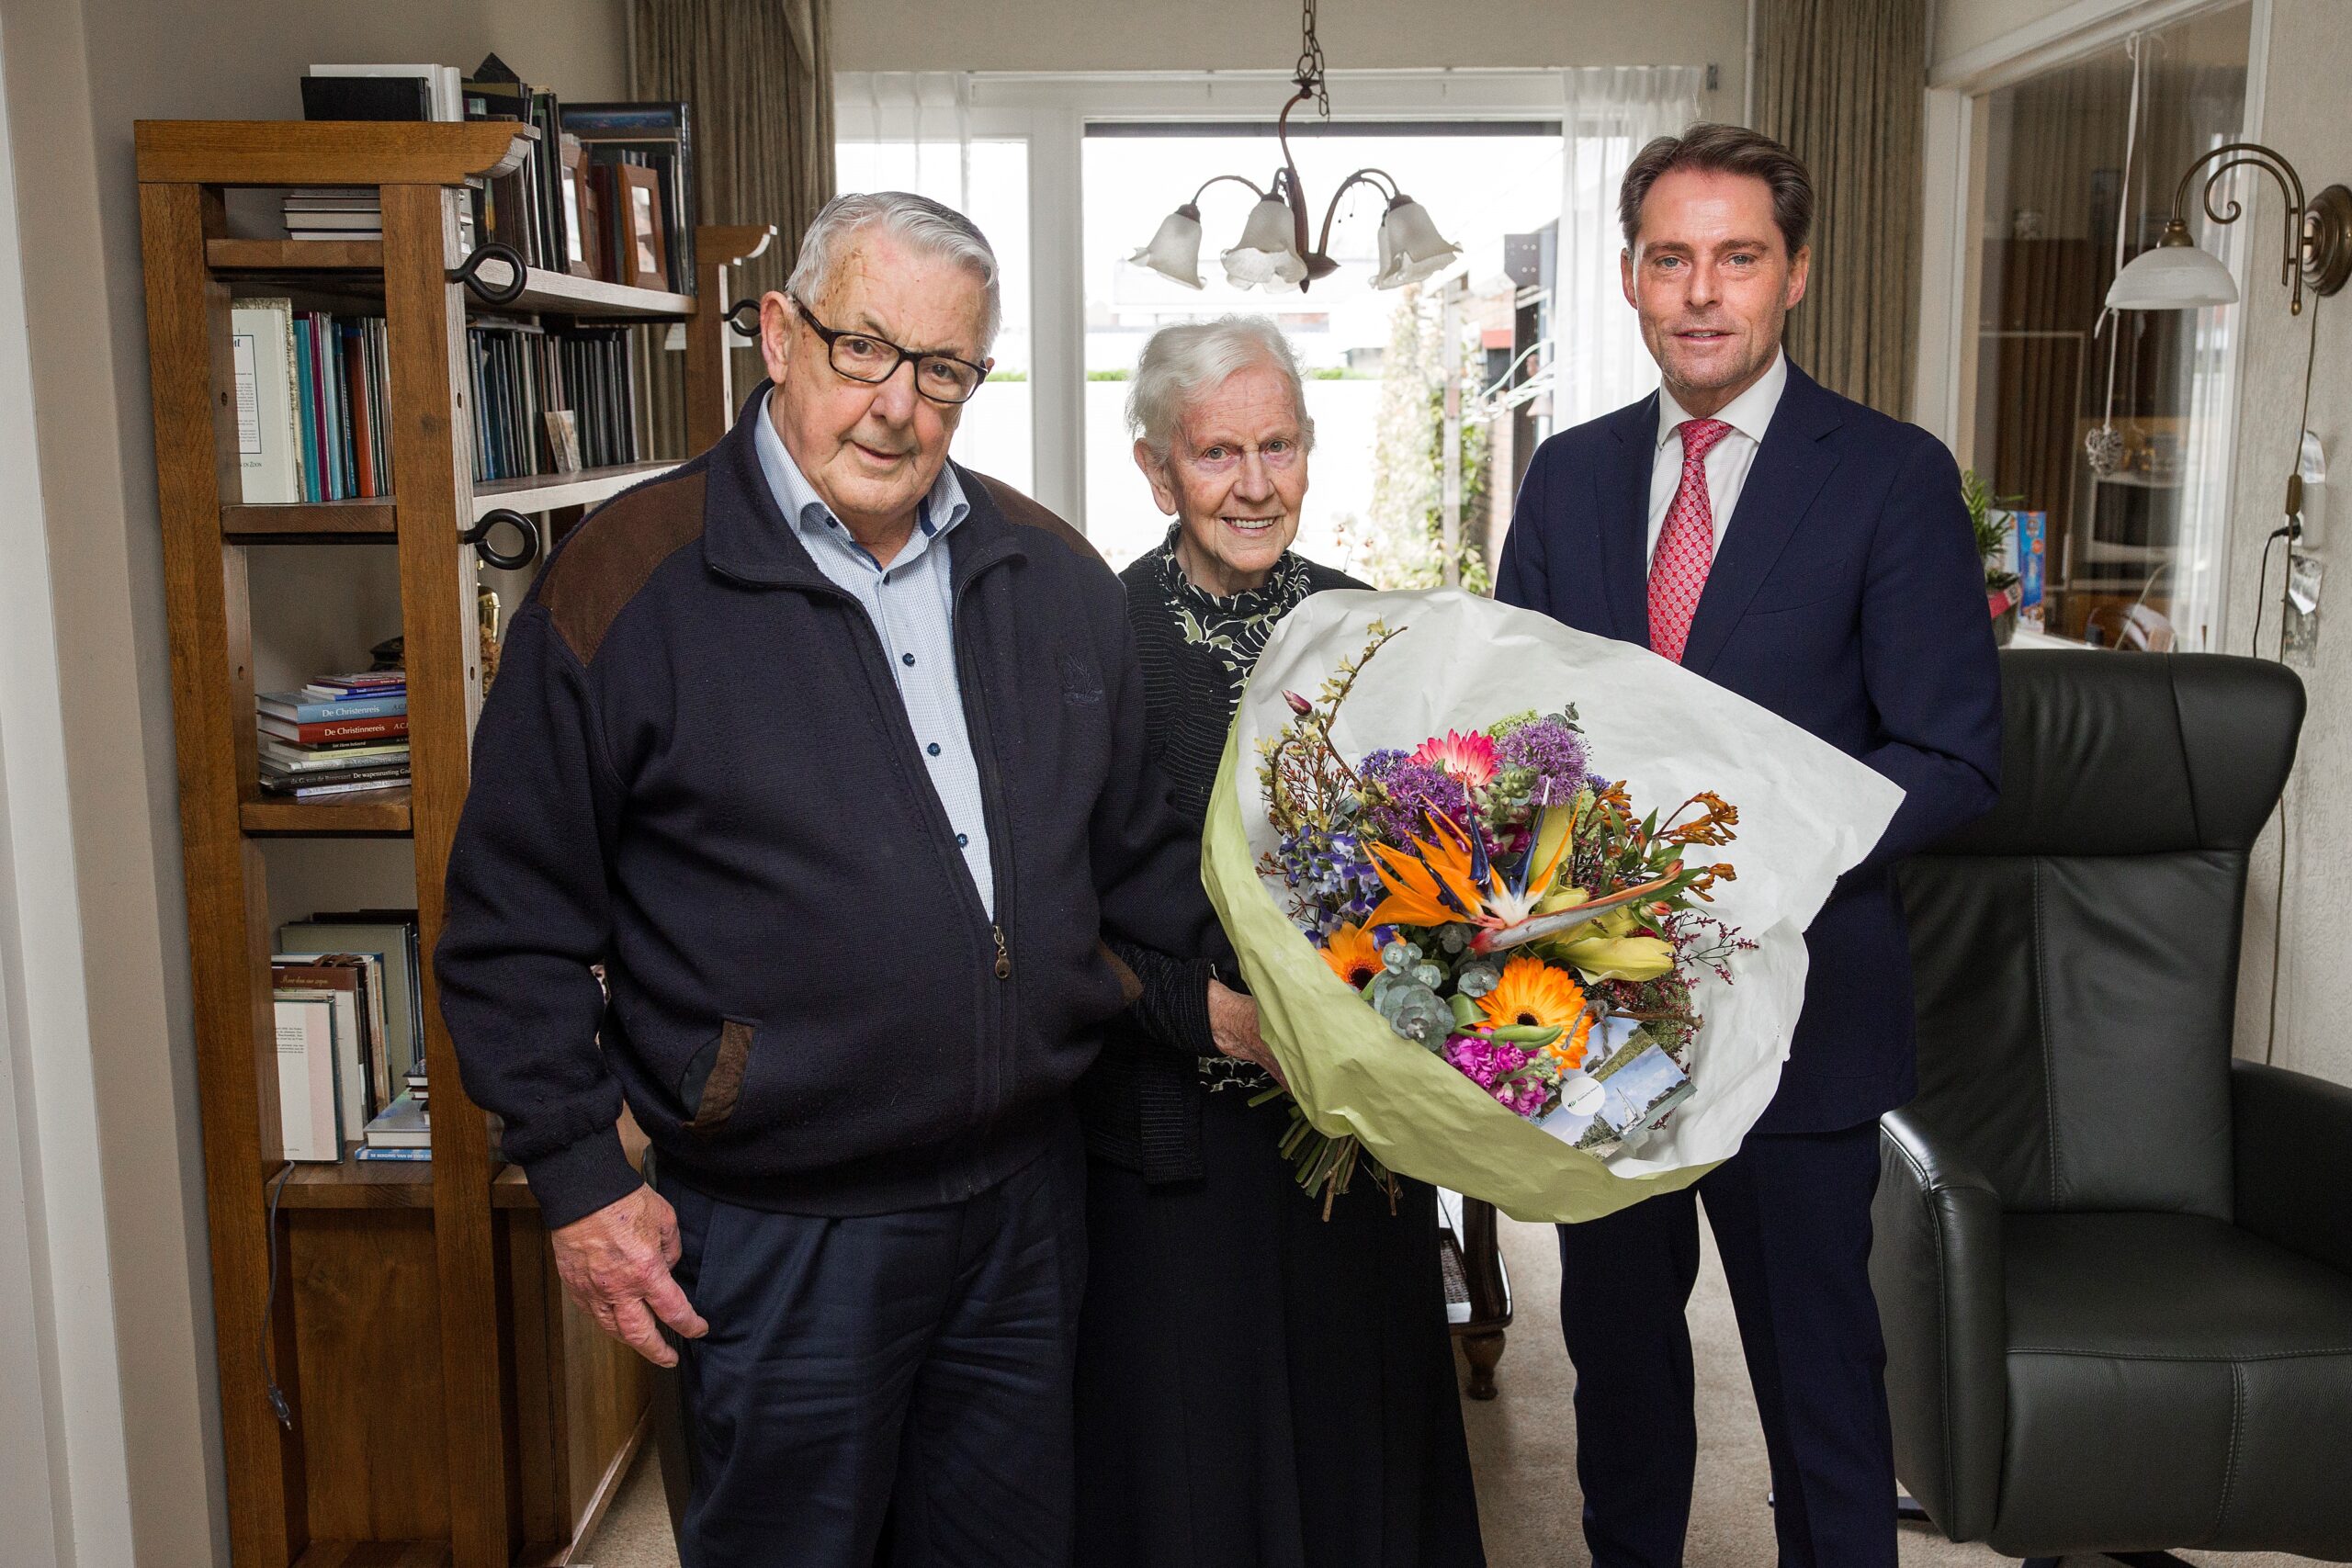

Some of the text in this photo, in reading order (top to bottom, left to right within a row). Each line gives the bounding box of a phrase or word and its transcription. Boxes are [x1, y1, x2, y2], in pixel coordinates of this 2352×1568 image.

[335, 705, 379, 716] Christenreis
[337, 724, 385, 735] Christinnereis
[362, 770, 399, 779] wapenrusting
